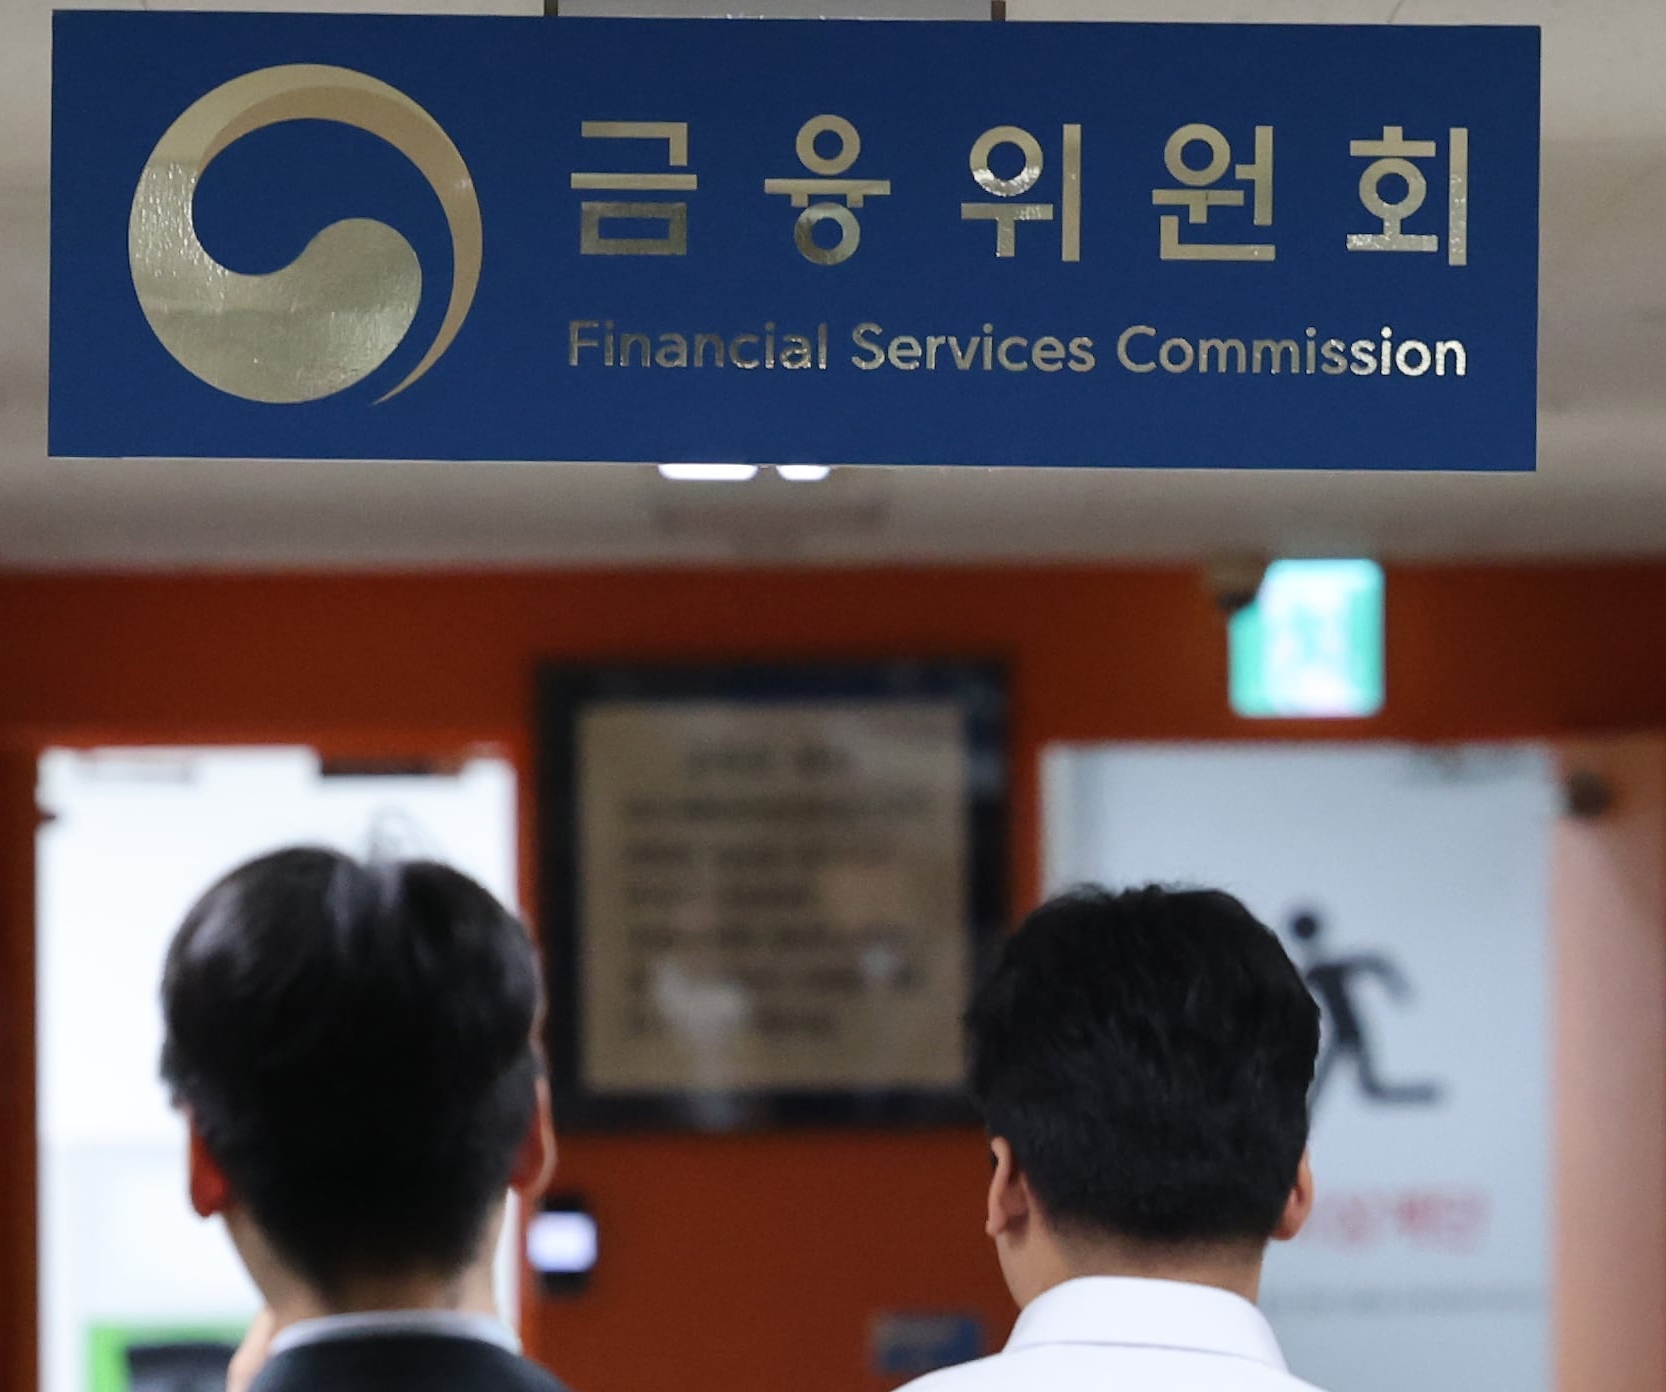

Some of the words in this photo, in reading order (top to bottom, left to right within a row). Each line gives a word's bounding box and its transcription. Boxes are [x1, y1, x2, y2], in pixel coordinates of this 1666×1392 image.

[569, 113, 1469, 267] 금융위원회
[568, 319, 829, 370] Financial
[850, 321, 1097, 374] Services
[1116, 324, 1467, 376] Commission
